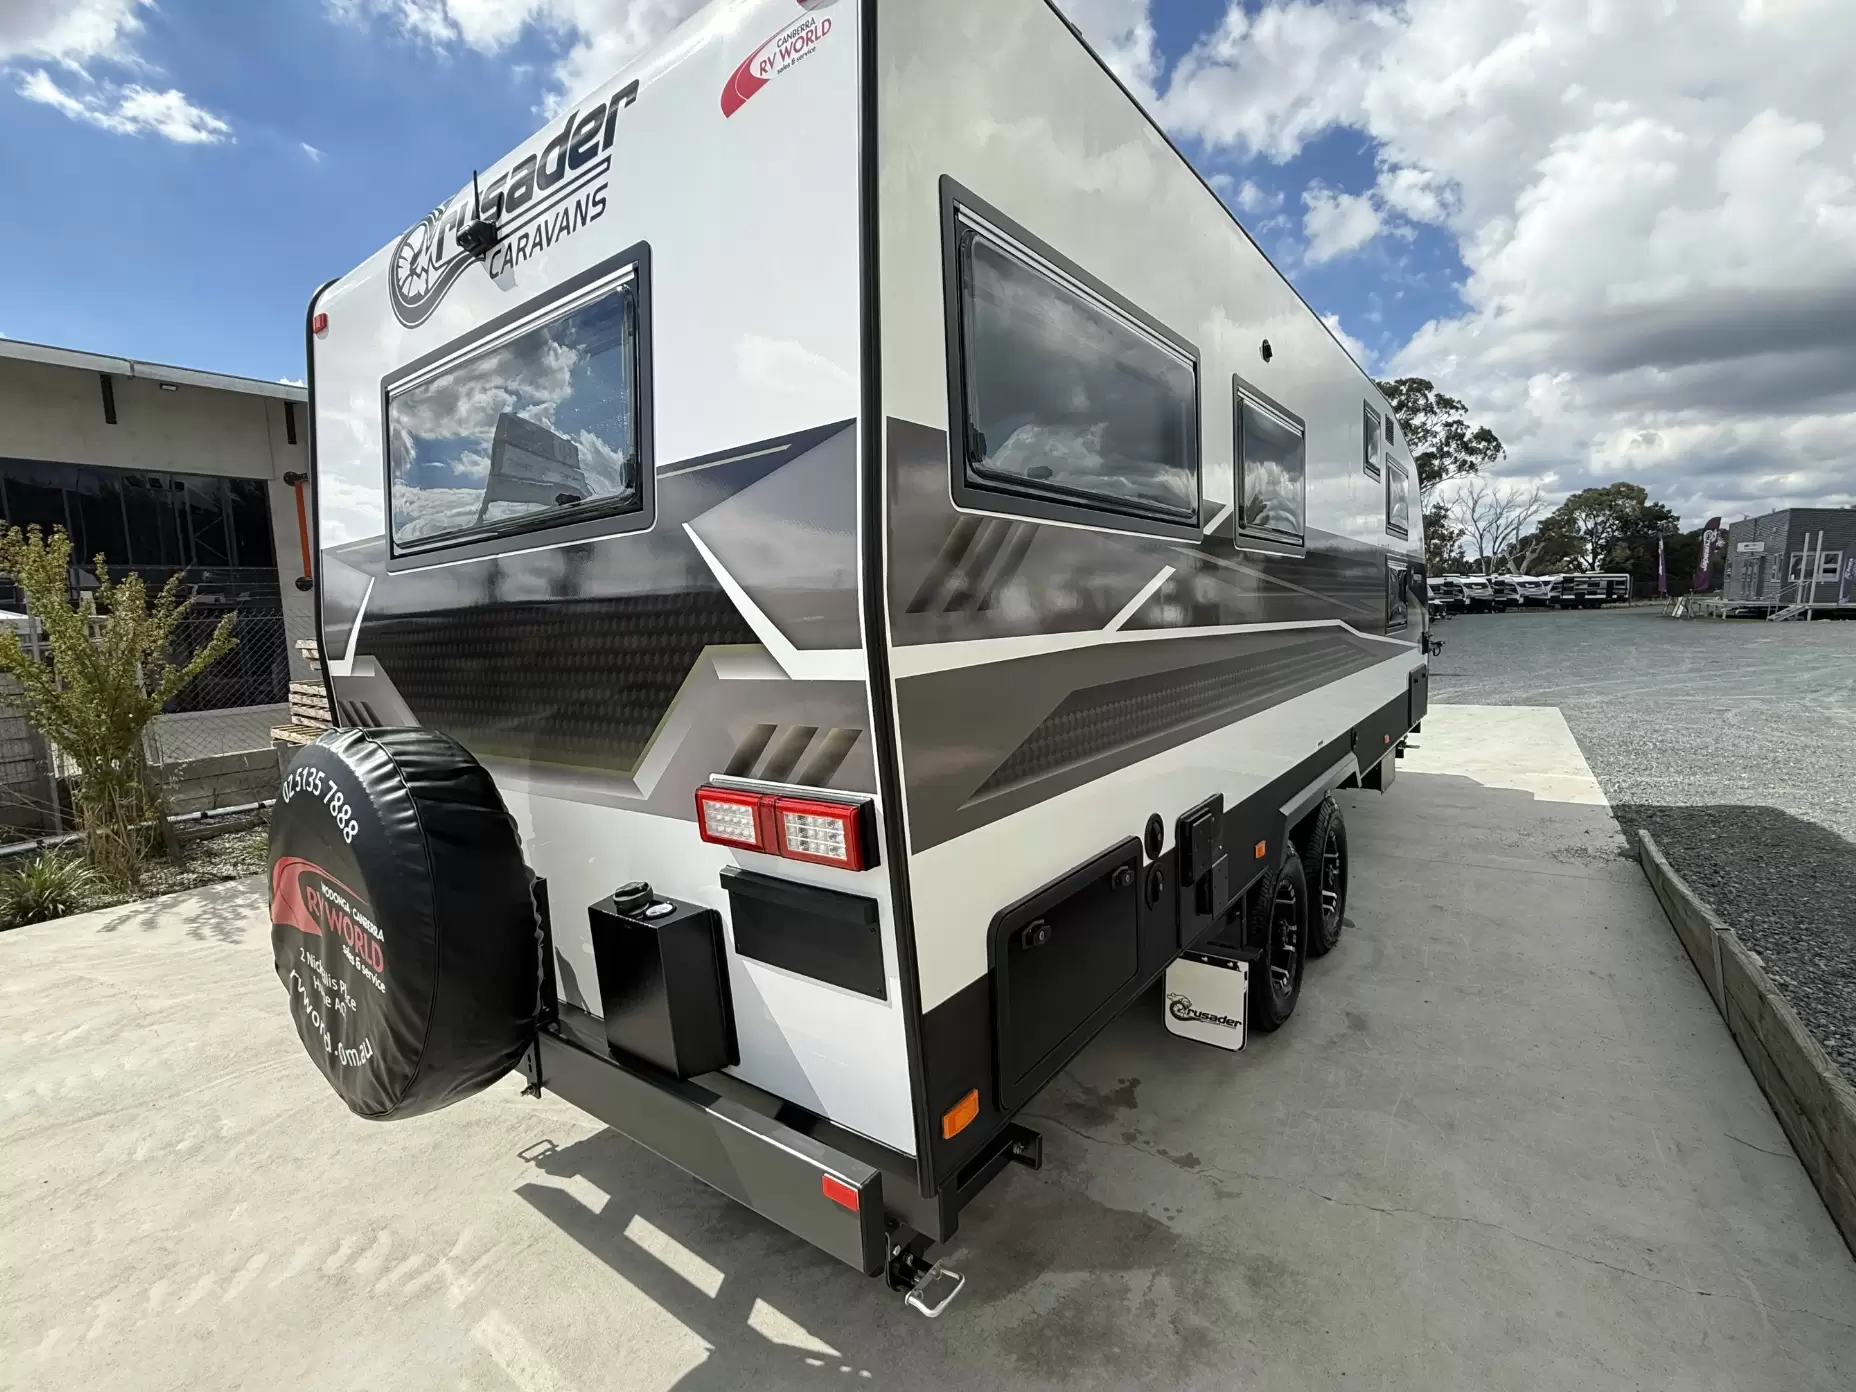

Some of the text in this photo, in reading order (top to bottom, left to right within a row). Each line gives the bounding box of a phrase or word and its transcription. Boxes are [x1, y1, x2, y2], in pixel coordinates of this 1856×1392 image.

[759, 17, 832, 77] RV WORLD
[776, 16, 816, 48] CANBERRA
[776, 61, 791, 75] sales
[796, 46, 817, 63] service
[489, 182, 609, 279] CARAVANS
[282, 766, 359, 844] 02 5135 7888
[306, 885, 384, 973] RV WORLD
[299, 947, 306, 962] 2
[361, 964, 386, 993] service
[1169, 999, 1243, 1029] Crusader
